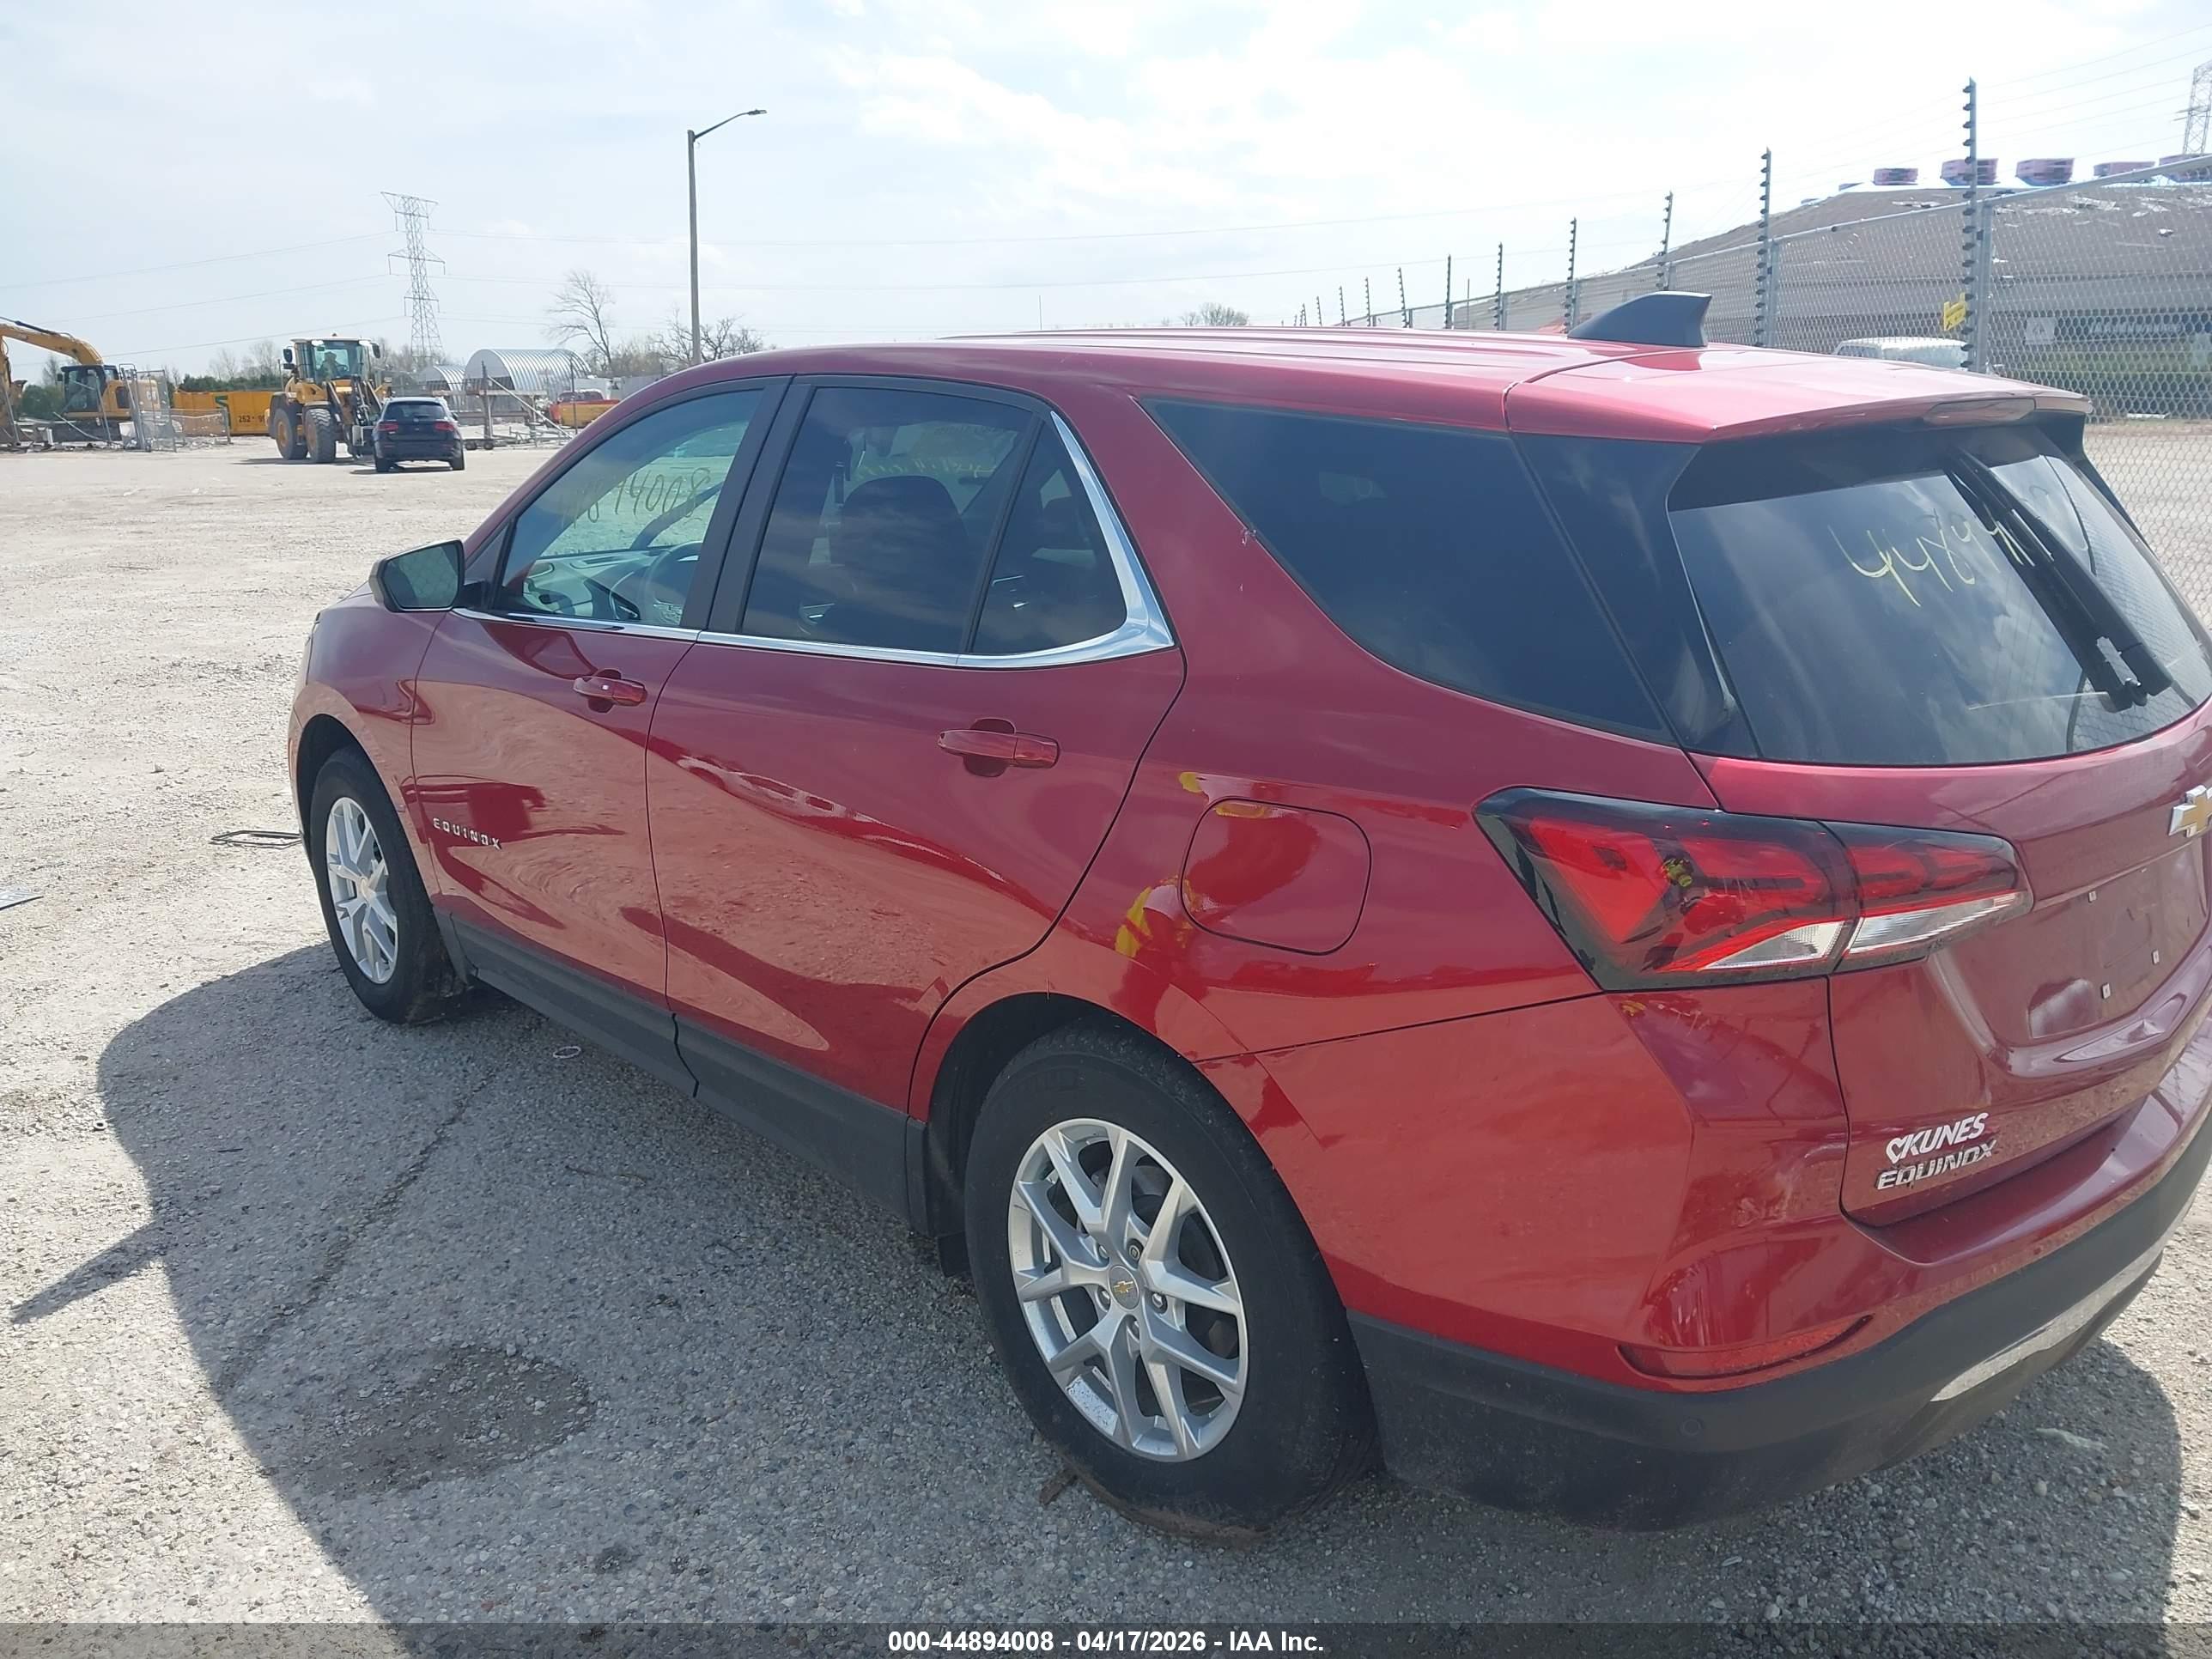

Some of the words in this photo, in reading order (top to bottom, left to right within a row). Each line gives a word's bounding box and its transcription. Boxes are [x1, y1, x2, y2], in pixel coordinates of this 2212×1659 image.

[432, 817, 501, 849] EQUINOX
[1898, 1113, 1990, 1160] KUNES
[1878, 1139, 1997, 1190] EQUINOX
